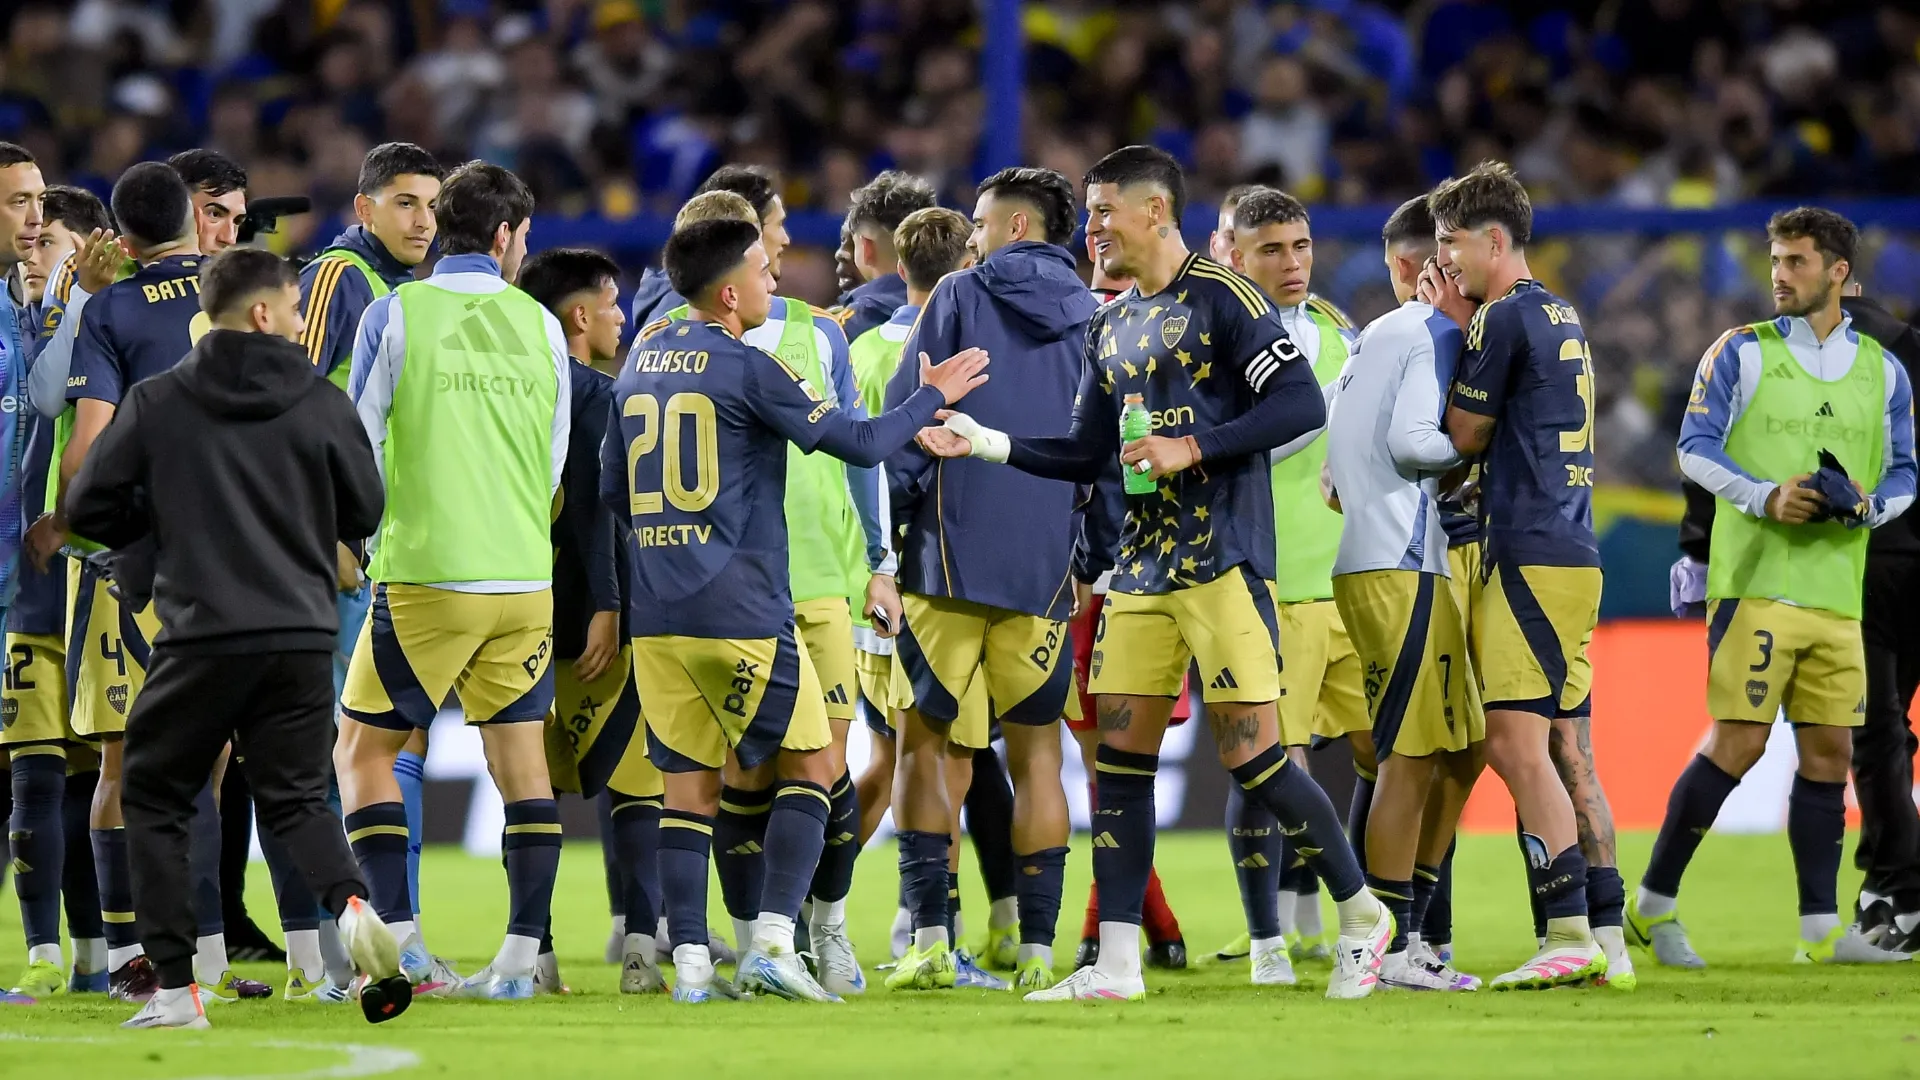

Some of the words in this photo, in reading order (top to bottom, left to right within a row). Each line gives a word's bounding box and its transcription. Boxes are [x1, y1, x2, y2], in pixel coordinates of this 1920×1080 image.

[635, 350, 709, 374] VELASCO
[435, 371, 537, 399] DIRECTV
[1766, 414, 1866, 444] betsson
[623, 392, 720, 516] 20
[4, 643, 36, 691] 12
[100, 632, 126, 676] 4
[1749, 629, 1774, 672] 3
[722, 658, 760, 717] pax
